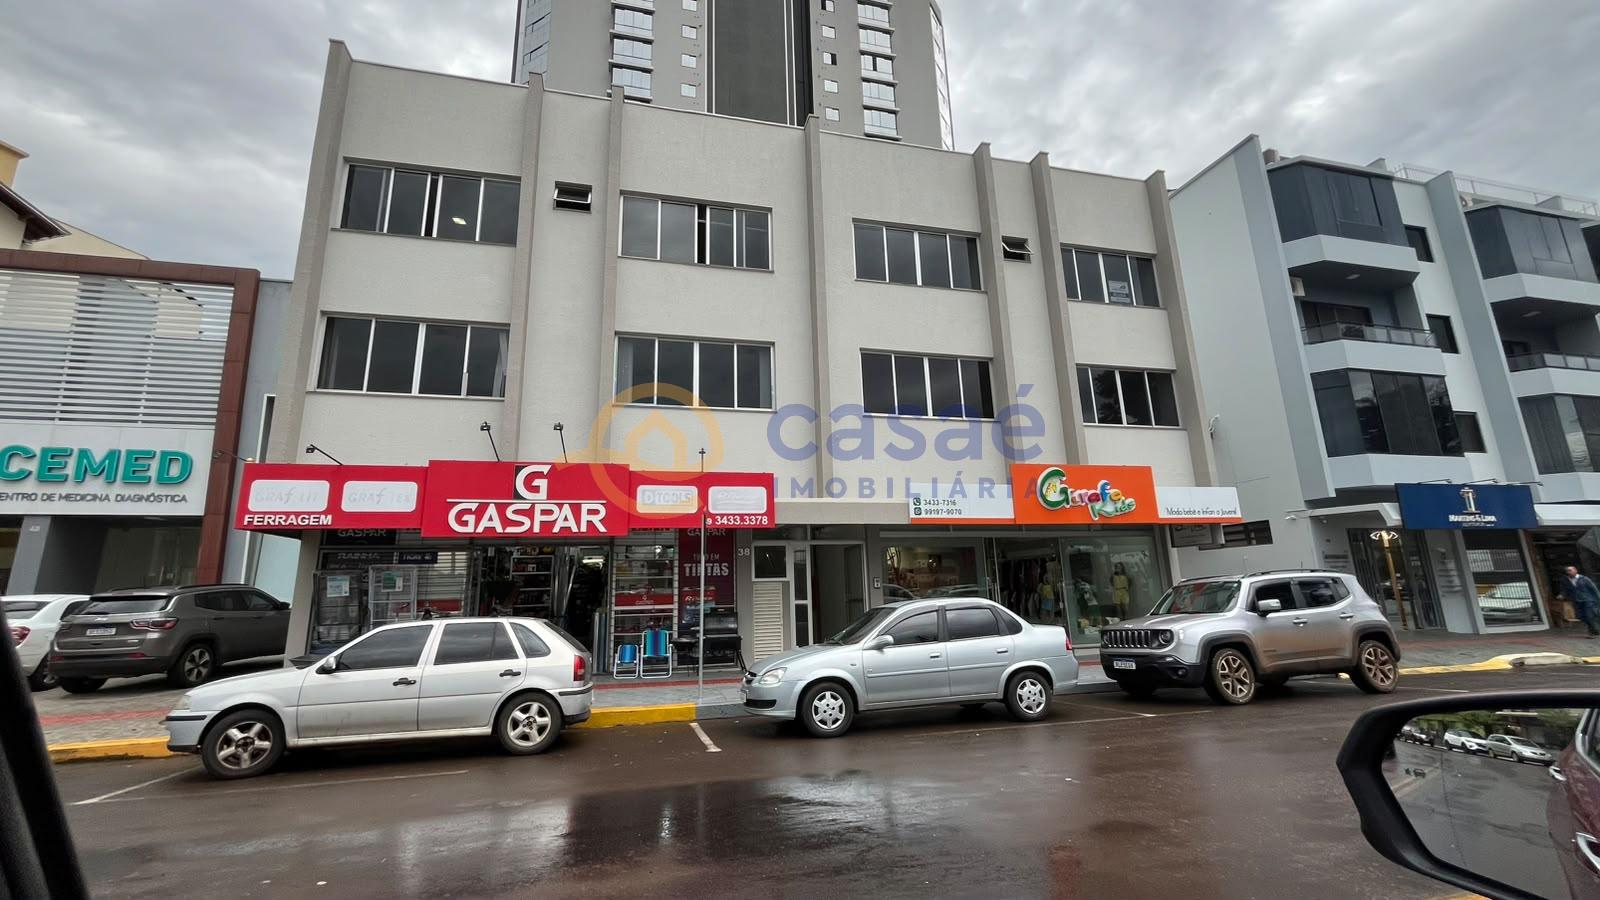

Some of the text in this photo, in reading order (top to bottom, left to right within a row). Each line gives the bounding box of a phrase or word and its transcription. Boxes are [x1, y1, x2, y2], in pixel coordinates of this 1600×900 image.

[0, 444, 194, 486] CEMED
[515, 464, 552, 501] G
[0, 492, 187, 503] ENTRO DE MEDICINA DIAGNÓSTICA
[243, 514, 333, 526] FERRAGEM
[447, 502, 608, 533] GASPAR
[715, 516, 769, 525] 3433.3378
[687, 528, 727, 537] GAPAR
[737, 548, 751, 556] 38
